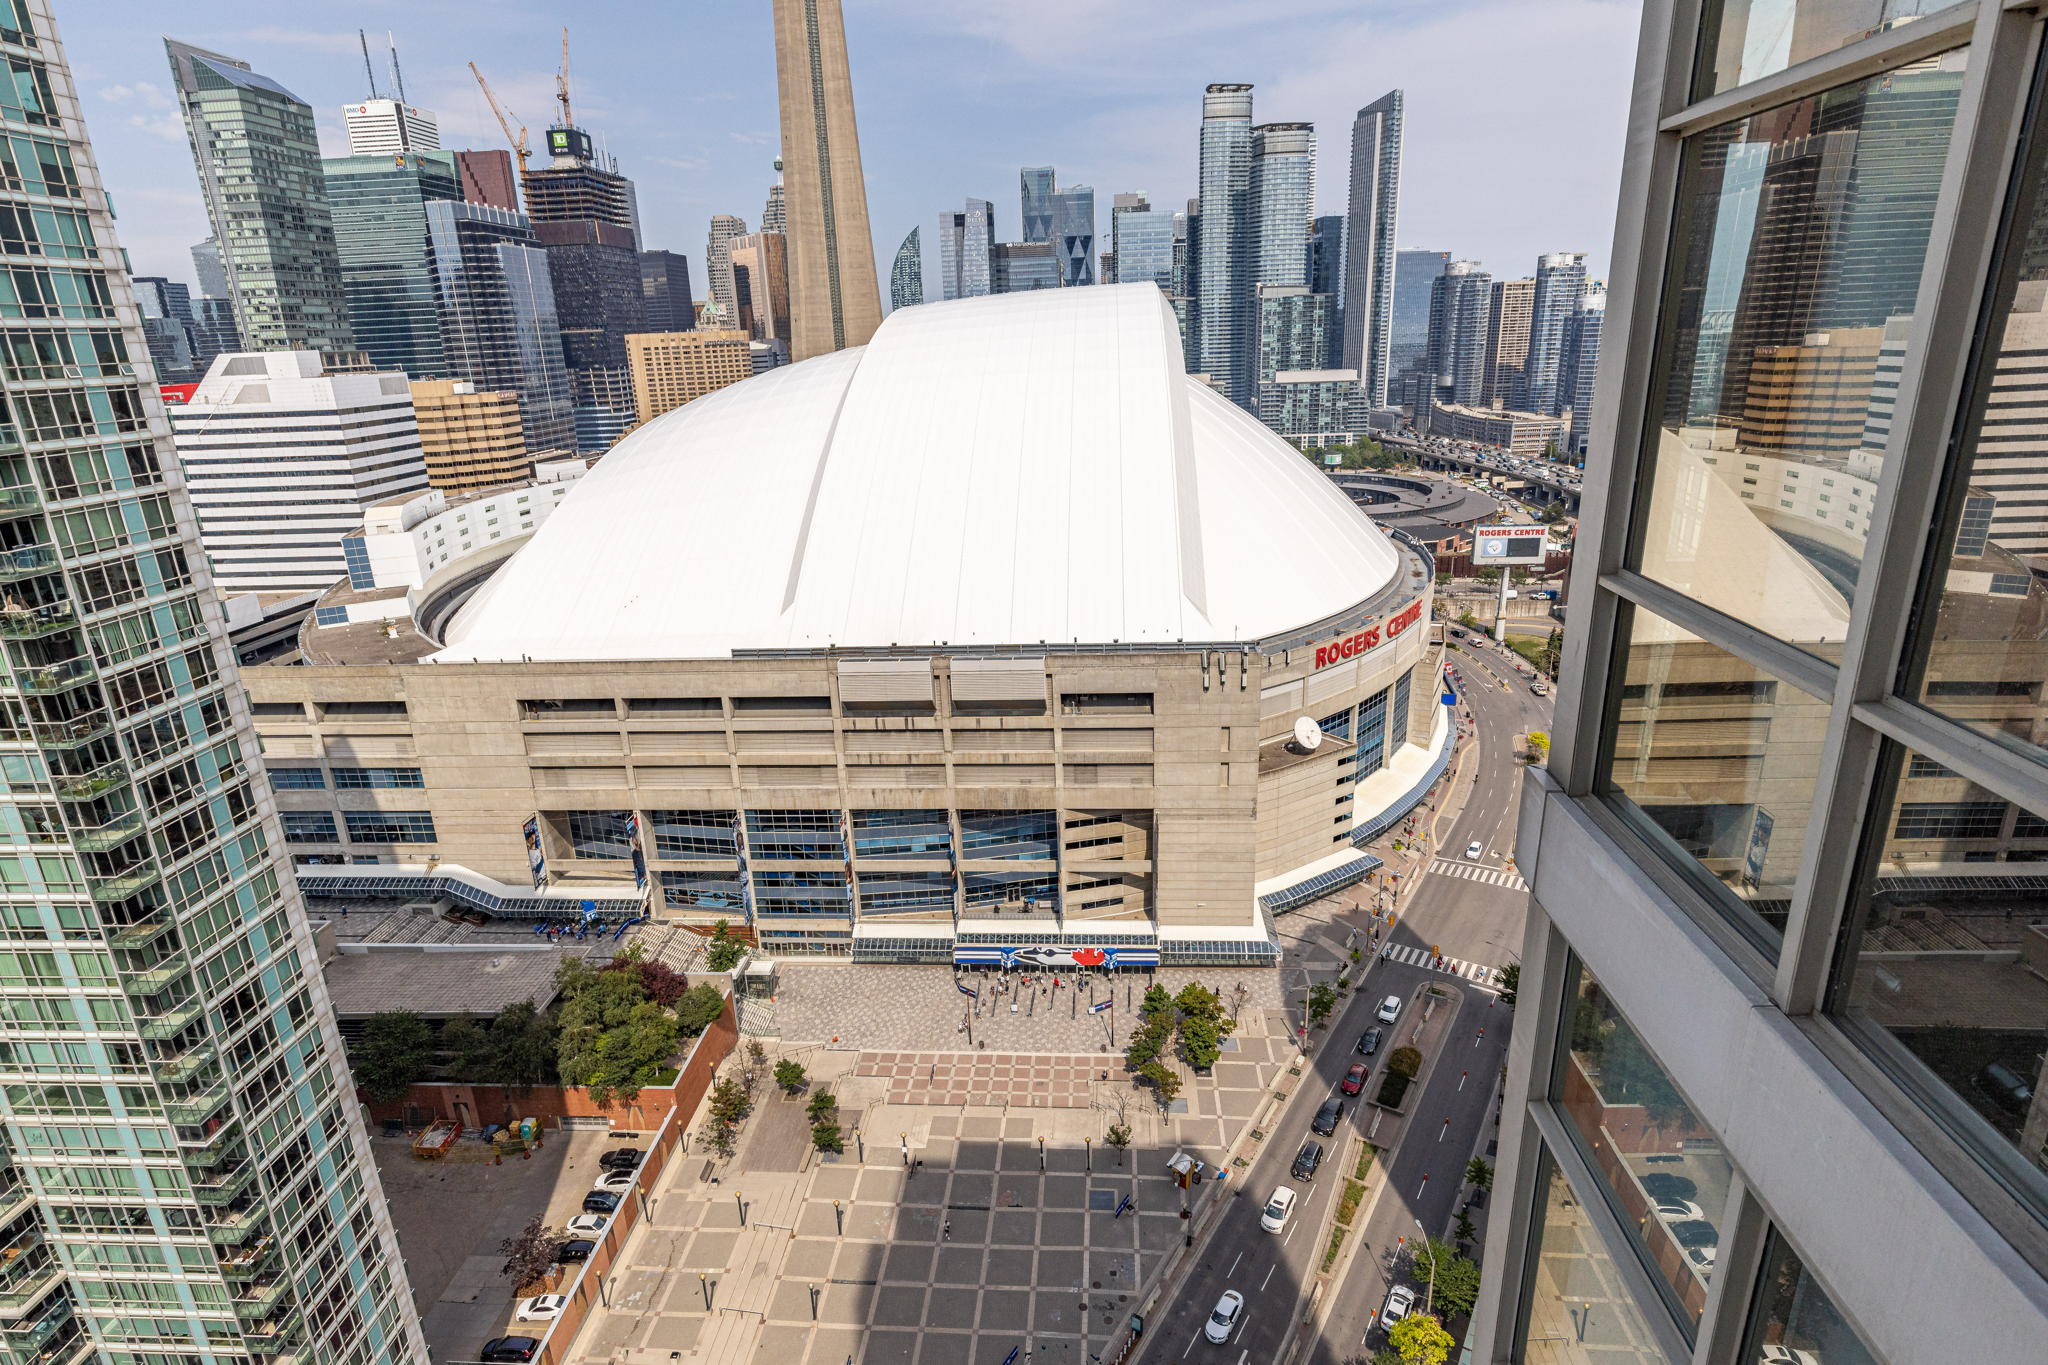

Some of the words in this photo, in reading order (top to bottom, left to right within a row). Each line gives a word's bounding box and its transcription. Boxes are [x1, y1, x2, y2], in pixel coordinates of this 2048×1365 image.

[554, 135, 566, 144] TD
[1514, 528, 1546, 536] CENTRE
[1315, 625, 1380, 669] ROGERS
[1386, 599, 1423, 638] CENTRE
